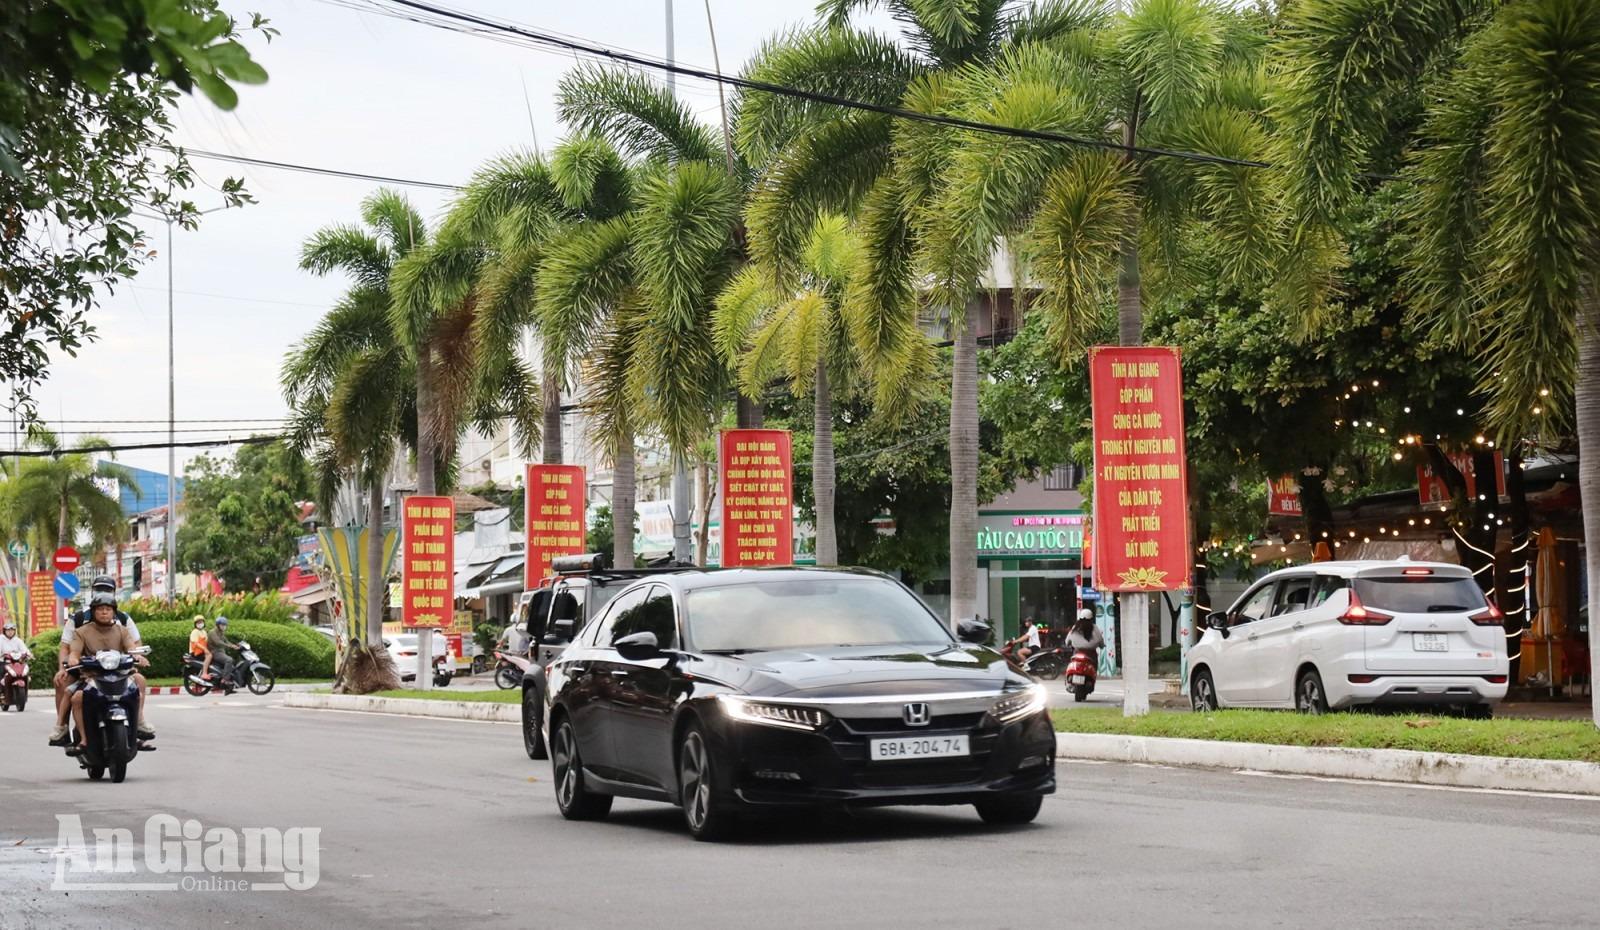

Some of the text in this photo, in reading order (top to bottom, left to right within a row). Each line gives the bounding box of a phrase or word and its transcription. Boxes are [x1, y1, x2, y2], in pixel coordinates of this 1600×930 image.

[1112, 358, 1160, 378] TỈNH AN GIANG
[1120, 385, 1133, 403] GÓP
[1113, 409, 1162, 429] CÙNG CẢ NƯỚC
[1101, 434, 1176, 455] TRONG KỶ NGUYÊN MỚI
[1104, 461, 1113, 480] KỶ
[1114, 462, 1141, 480] NGUYÊN
[1142, 464, 1160, 480] VƯƠN
[1161, 462, 1180, 479] MÌNH
[1119, 486, 1162, 509] CỦA DÂN TỘC
[1122, 510, 1160, 532] PHÁT TRIỂN
[1004, 531, 1034, 549] CAO
[1037, 527, 1066, 548] TỐC
[1125, 537, 1158, 558] ĐẤT NƯỚC
[880, 740, 960, 756] 68A-204.74
